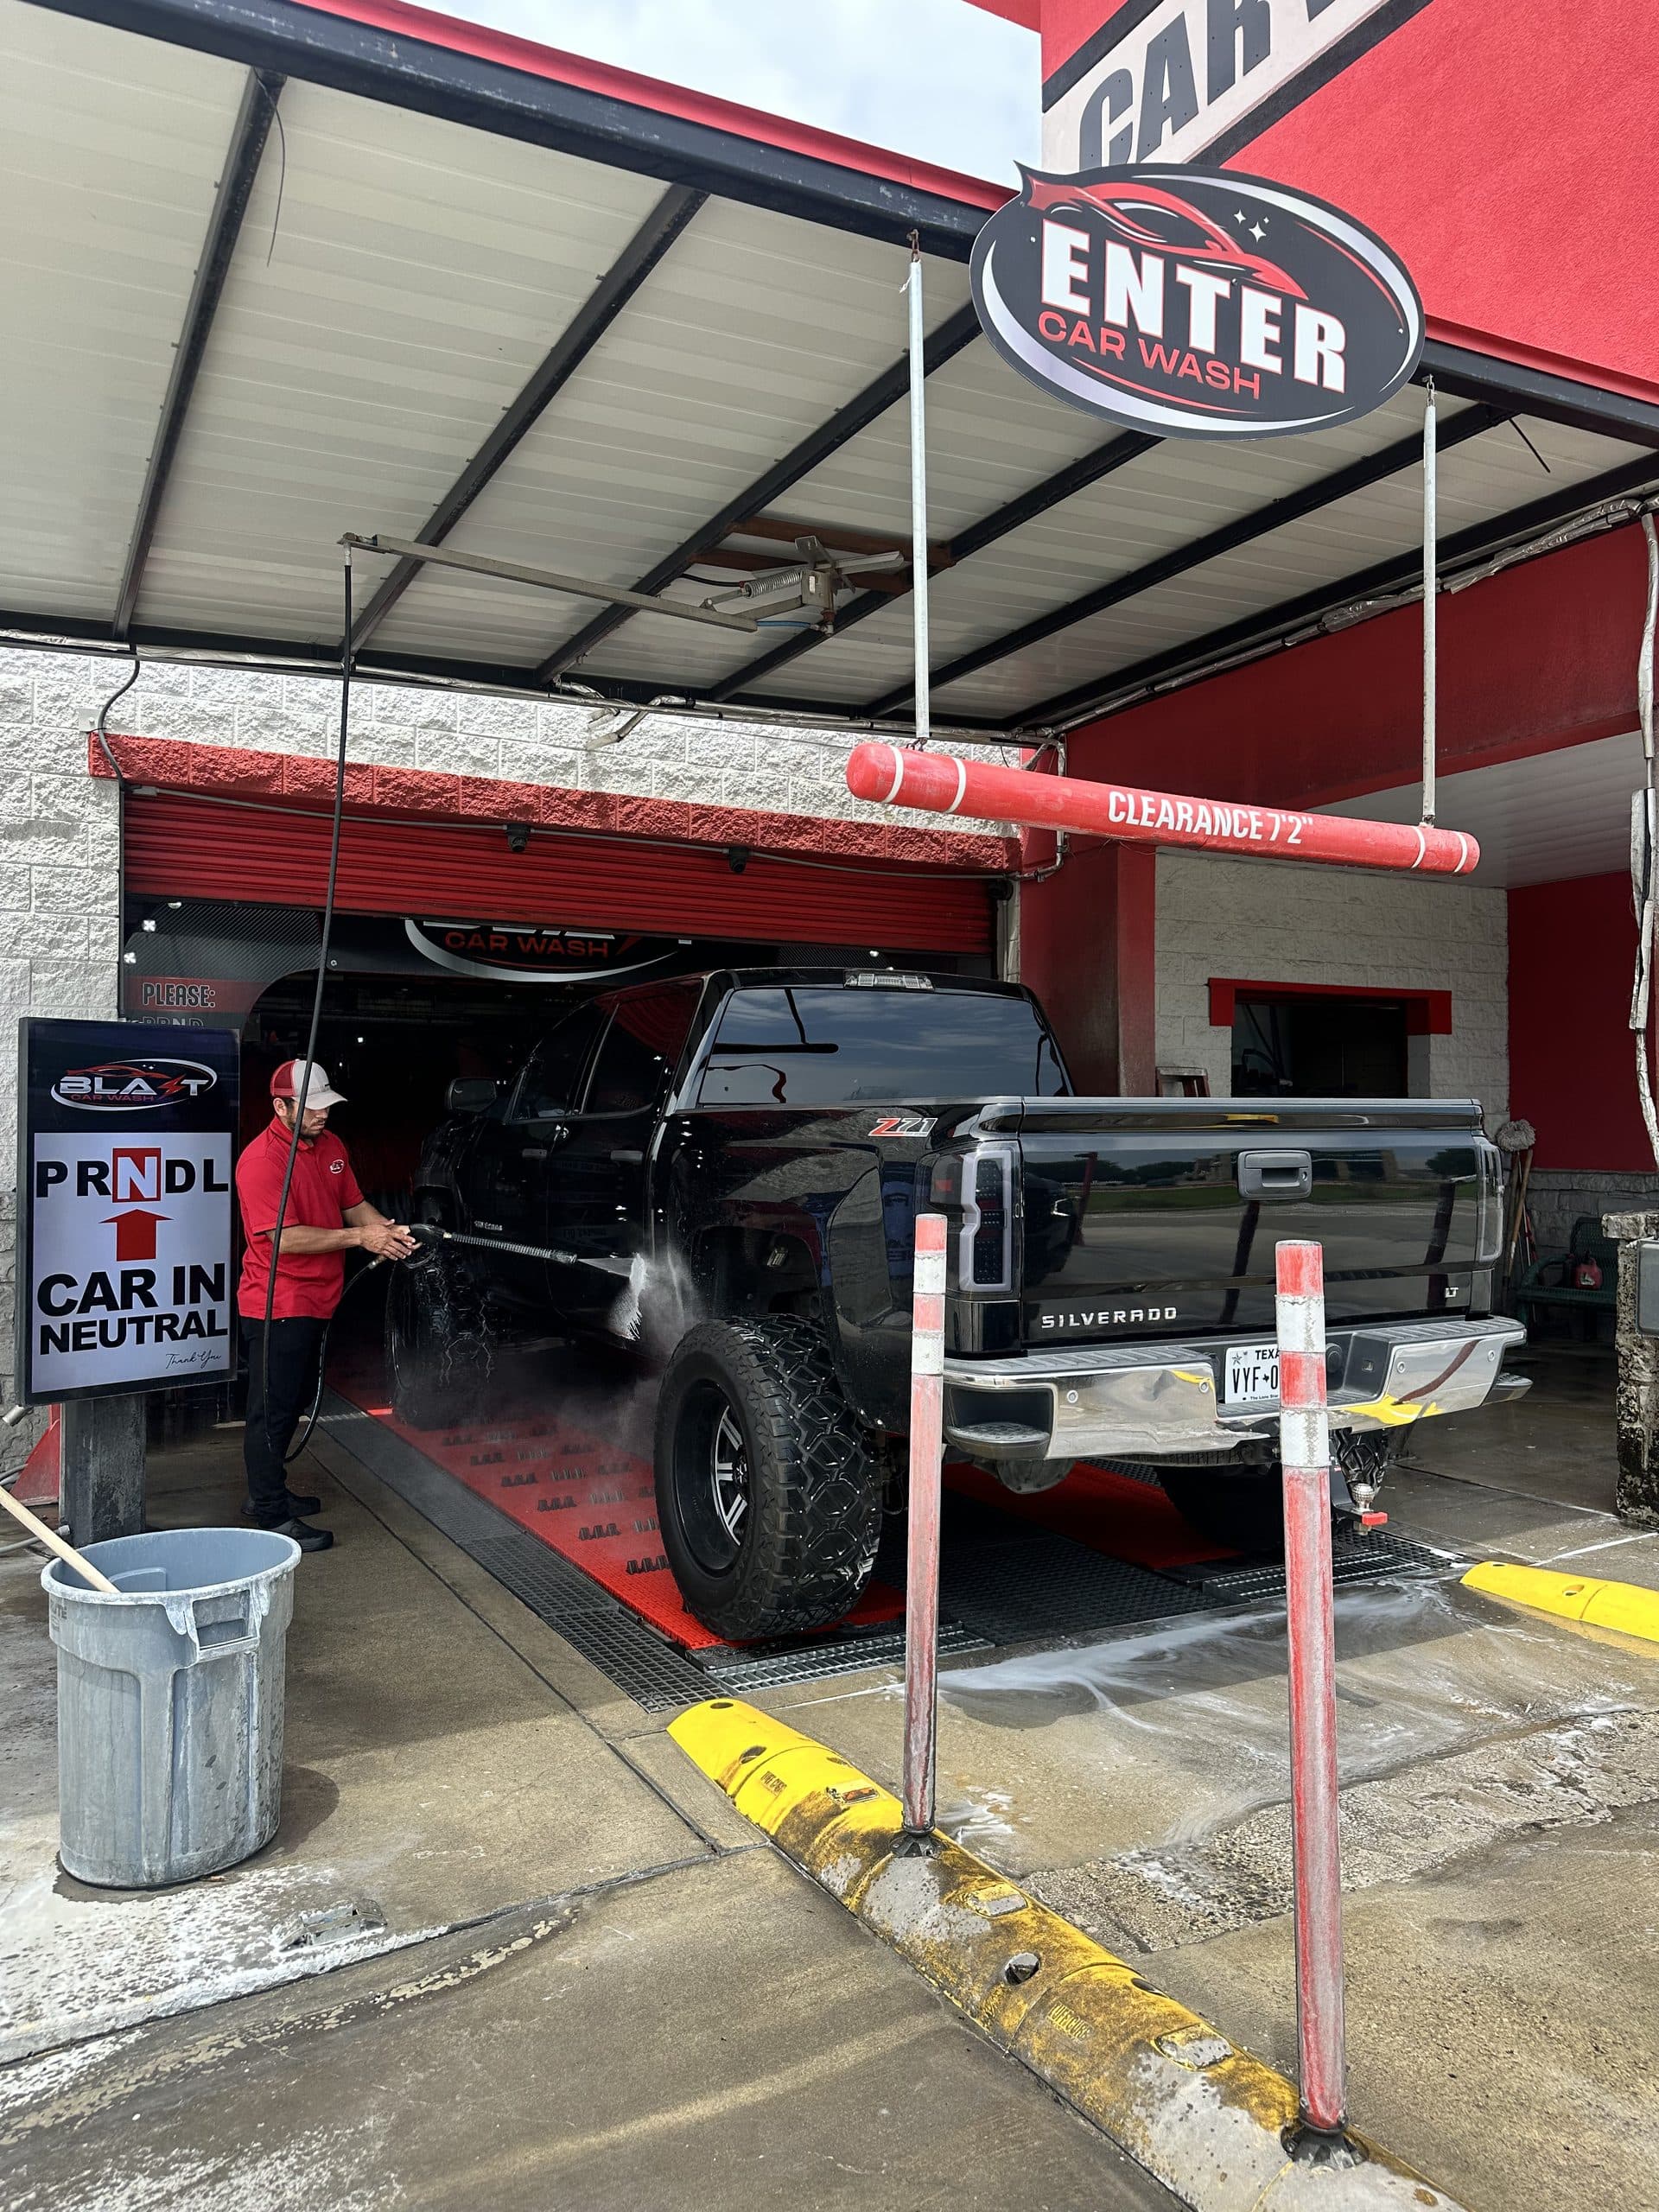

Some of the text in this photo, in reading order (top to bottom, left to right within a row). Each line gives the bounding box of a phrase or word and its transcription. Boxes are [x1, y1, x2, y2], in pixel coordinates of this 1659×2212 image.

[1079, 0, 1270, 168] CAR
[1041, 218, 1345, 393] ENTER
[1038, 310, 1260, 399] CAR WASH
[1108, 791, 1313, 843] CLEARANCE 7'2"
[445, 931, 508, 951] CAR
[517, 936, 608, 957] WASH
[143, 982, 215, 1007] PLEASE:
[868, 1117, 938, 1137] Z71
[37, 1263, 225, 1317] CAR IN
[1445, 1287, 1459, 1298] LT
[1041, 1306, 1177, 1328] SILVERADO
[40, 1309, 228, 1355] NEUTRAL
[165, 1349, 222, 1370] Thank You
[1255, 1348, 1280, 1360] TEXA
